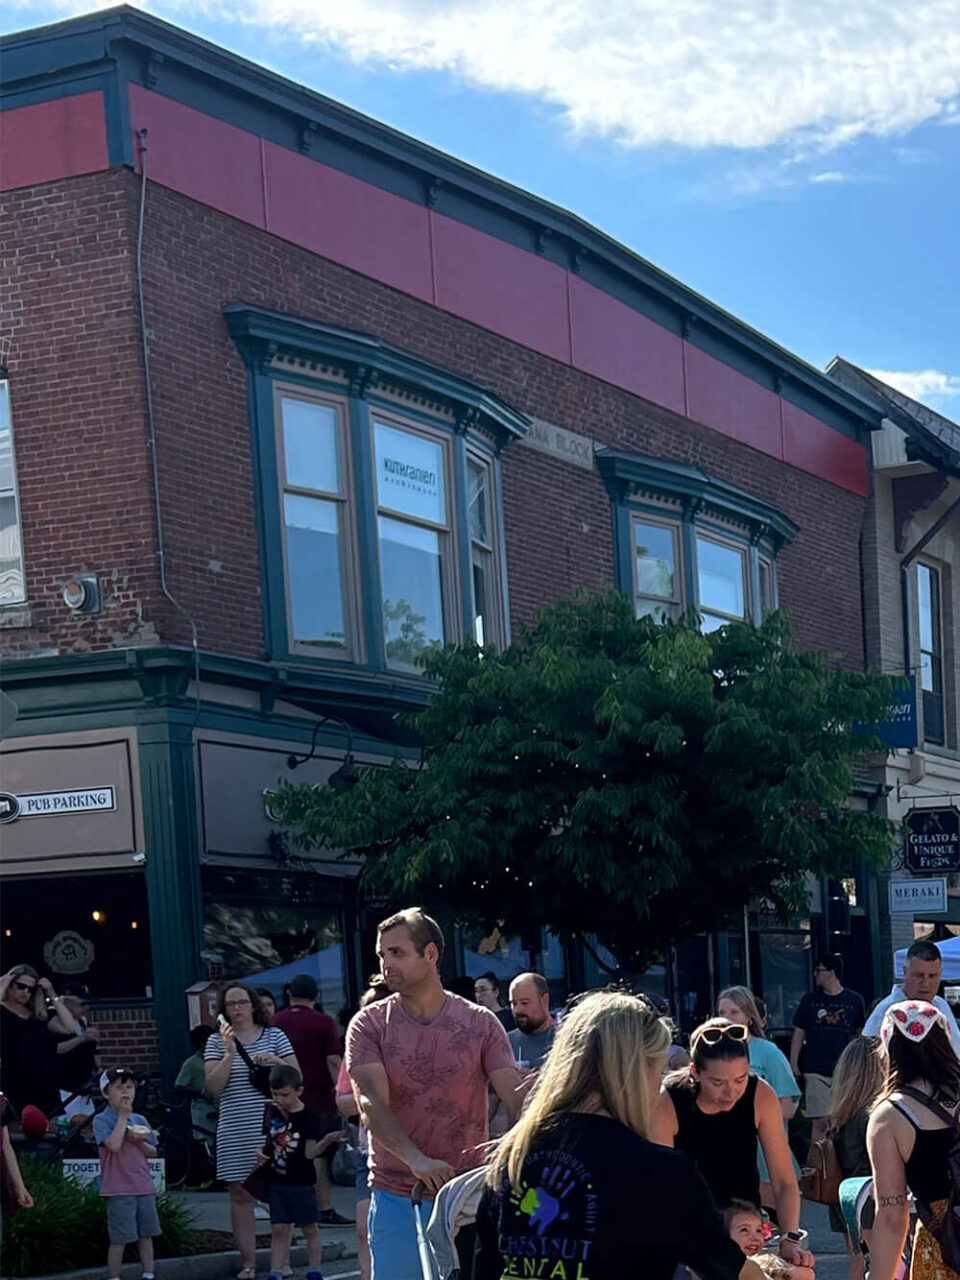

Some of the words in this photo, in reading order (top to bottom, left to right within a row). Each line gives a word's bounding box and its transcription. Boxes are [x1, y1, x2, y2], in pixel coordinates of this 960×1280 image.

[556, 432, 591, 460] BLOCK
[27, 798, 51, 811] PUB
[53, 793, 107, 809] PARKING
[910, 834, 949, 844] GELATO
[914, 845, 954, 856] UNIQUE
[895, 886, 940, 897] MERAKI
[67, 1162, 101, 1173] TOGET
[498, 1236, 592, 1260] CHESTNUT
